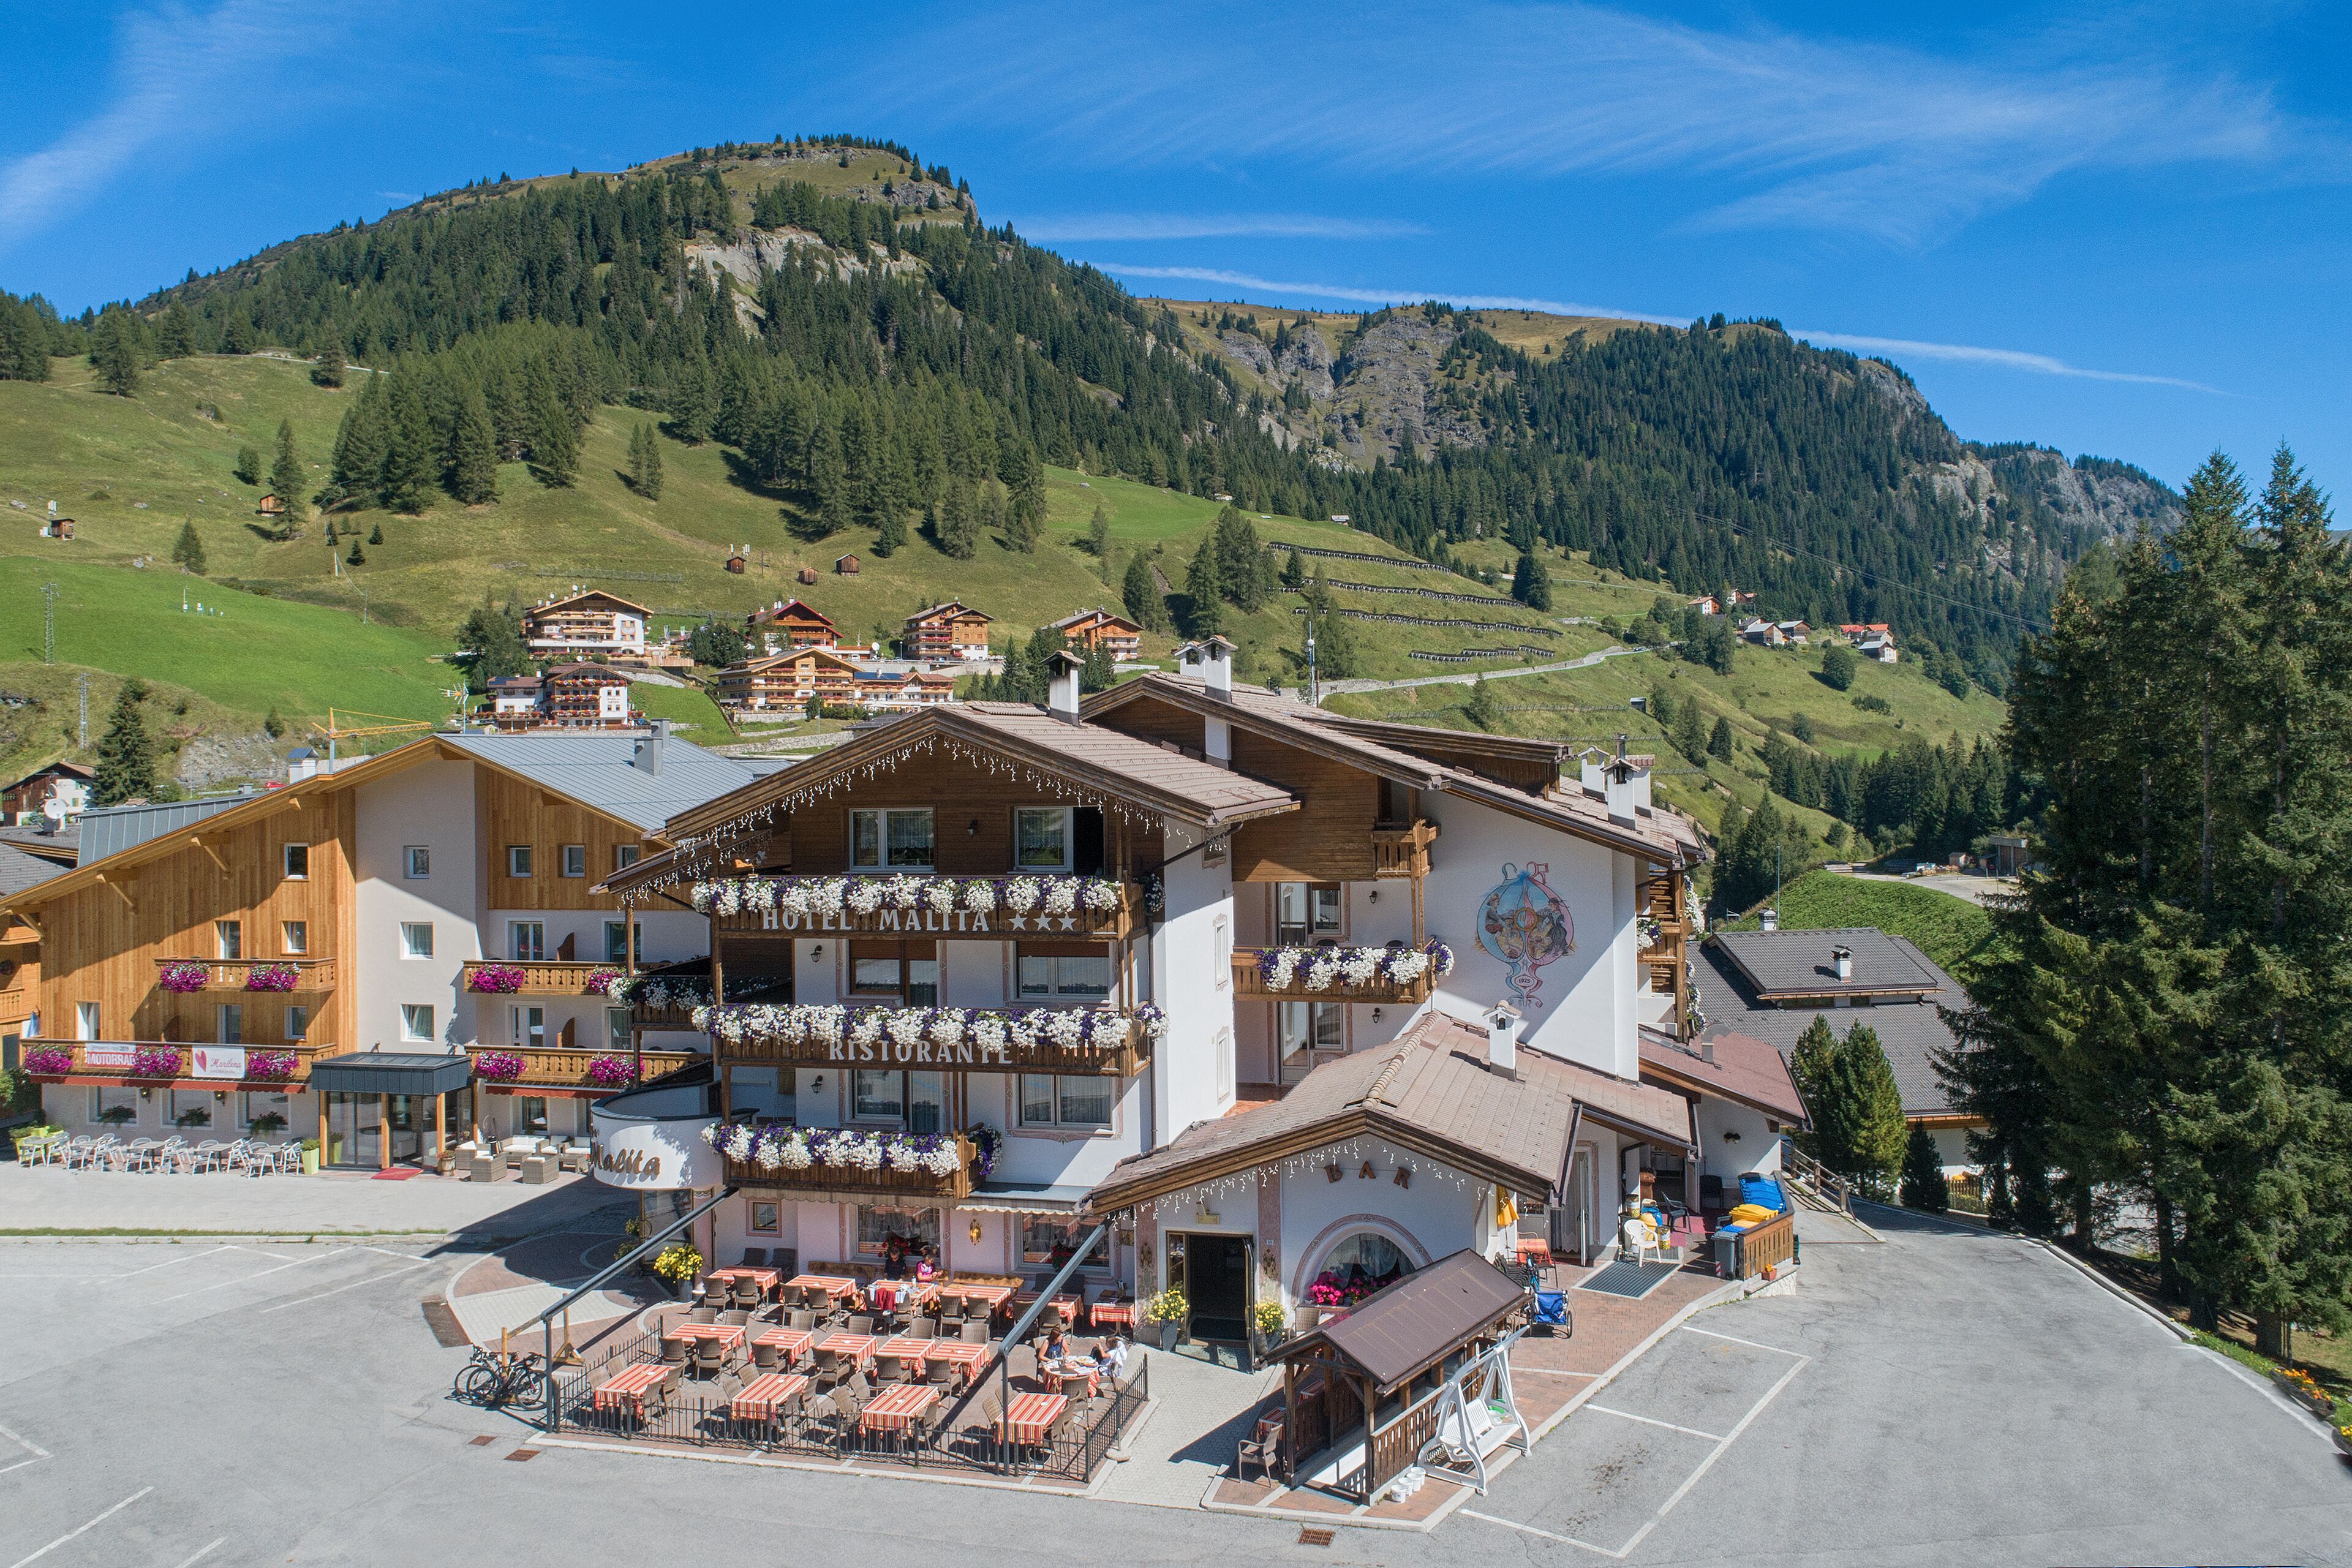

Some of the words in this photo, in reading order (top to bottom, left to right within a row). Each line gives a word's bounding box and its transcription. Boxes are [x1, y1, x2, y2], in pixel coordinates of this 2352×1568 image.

[763, 909, 853, 930] HOTEL
[879, 909, 990, 932] MALITA
[590, 1137, 662, 1175] Malita
[1324, 1161, 1411, 1189] BAR
